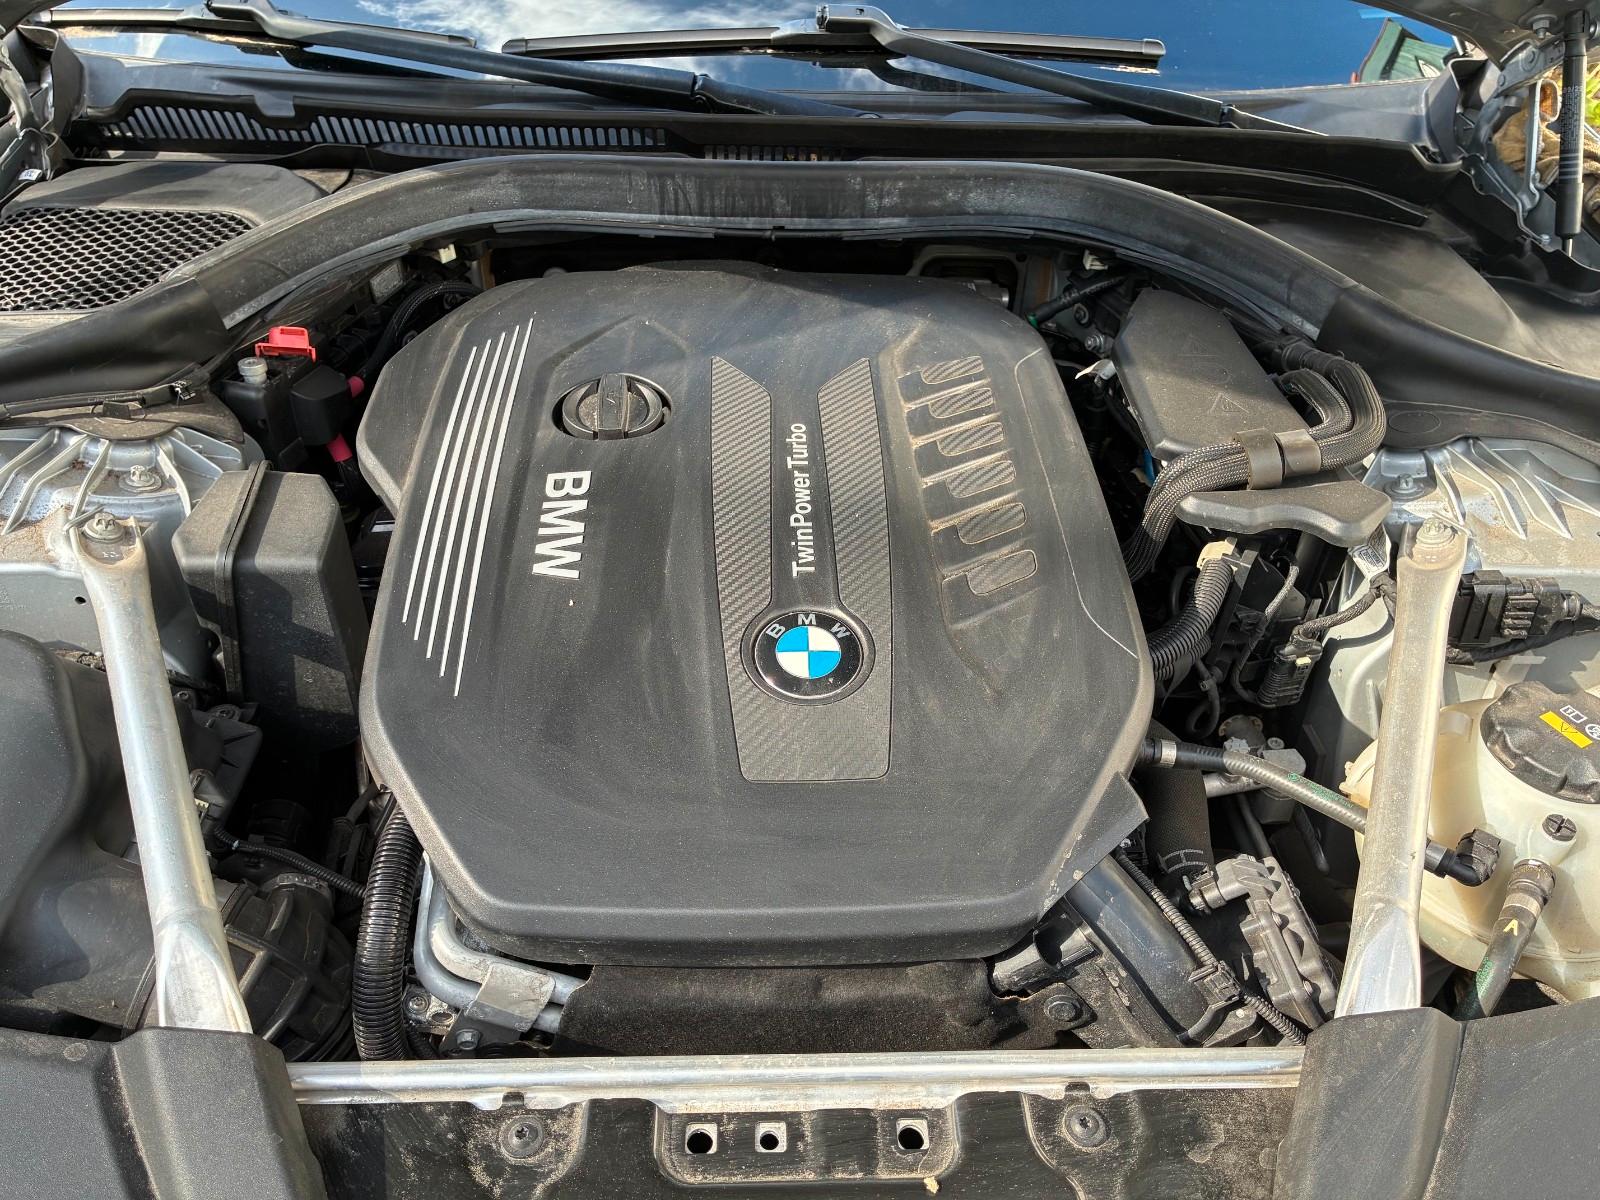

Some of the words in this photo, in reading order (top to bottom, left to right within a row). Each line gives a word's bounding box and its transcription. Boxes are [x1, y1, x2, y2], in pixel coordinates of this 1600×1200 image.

[786, 423, 809, 469] Turbo
[532, 470, 592, 580] BMW
[789, 470, 816, 577] TwinPower
[766, 613, 851, 639] BMW
